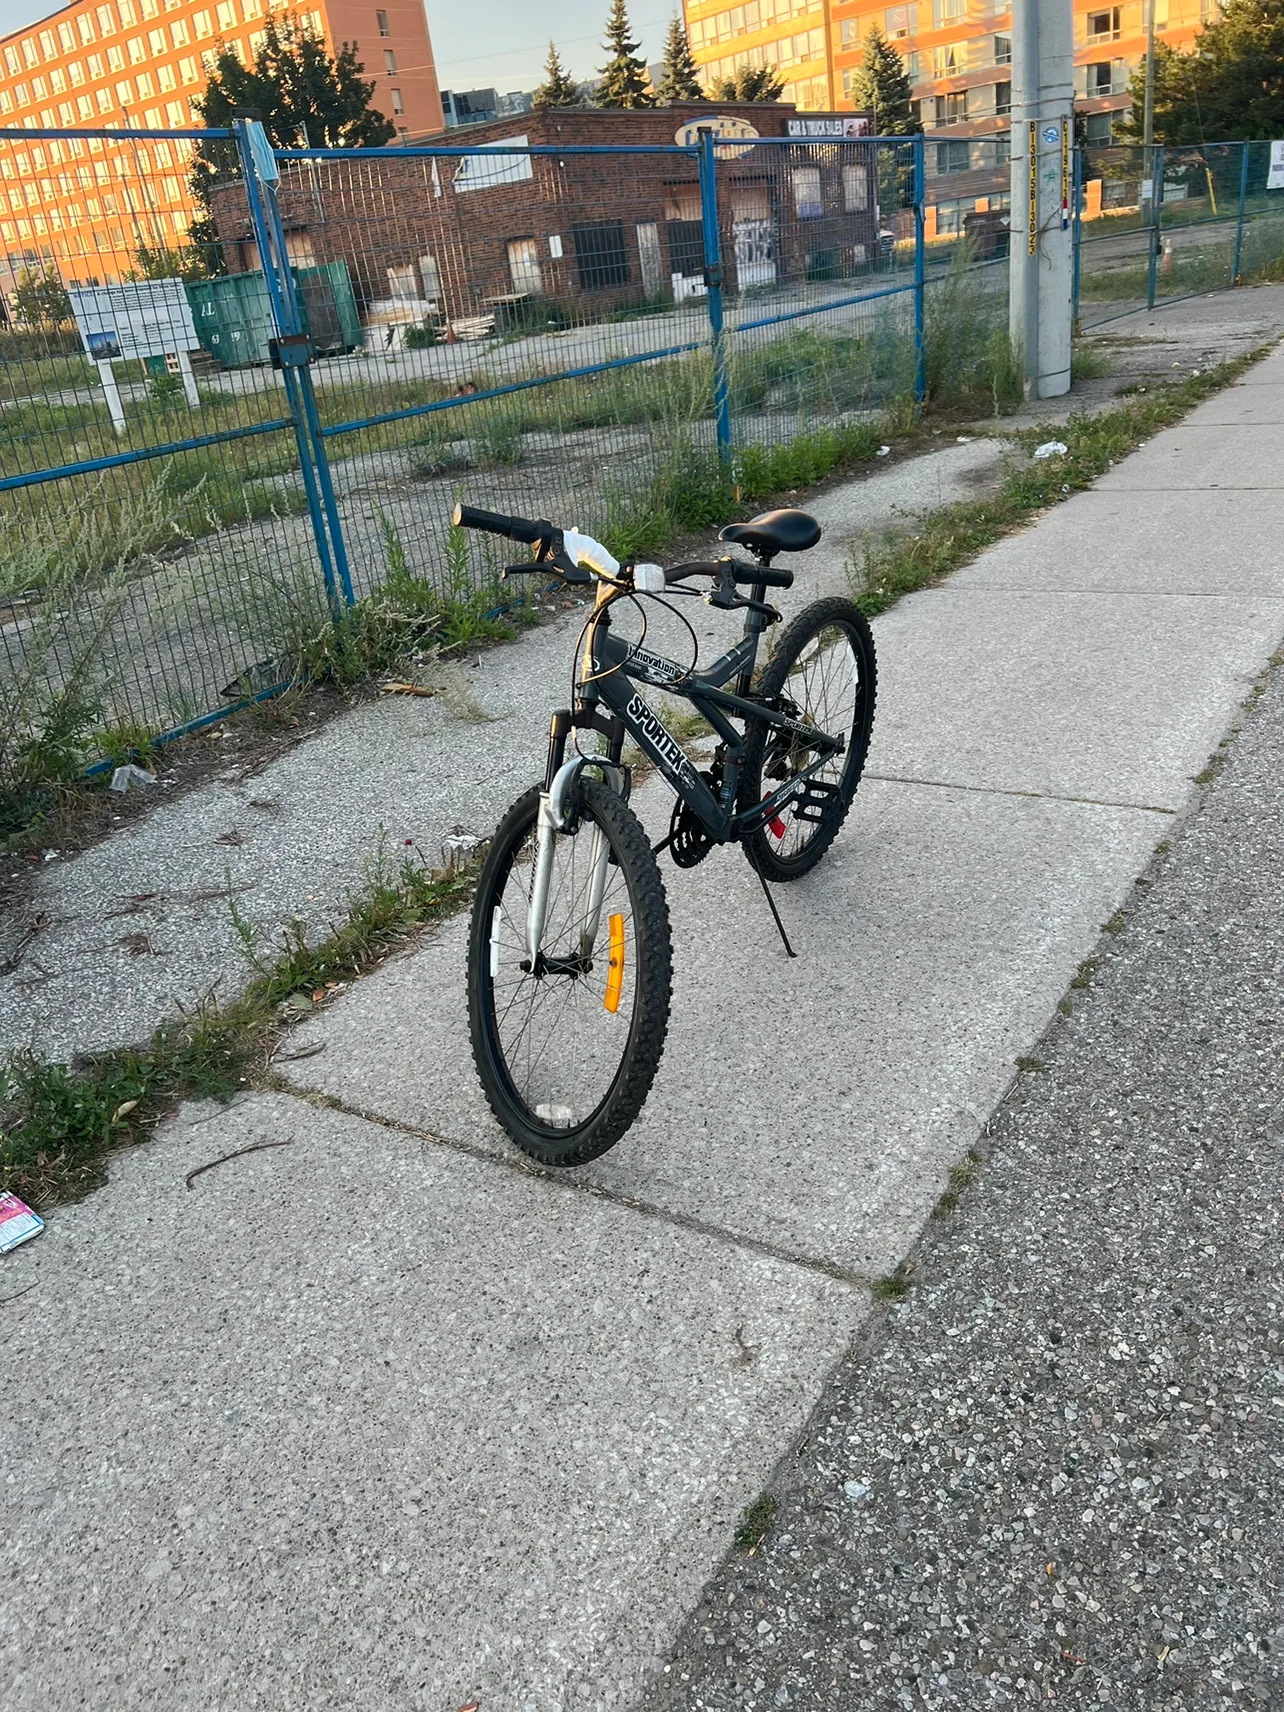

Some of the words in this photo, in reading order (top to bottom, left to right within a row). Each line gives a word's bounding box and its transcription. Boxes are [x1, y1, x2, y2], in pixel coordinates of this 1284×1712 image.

[788, 120, 801, 136] CAR
[806, 120, 826, 136] TRUCK
[626, 693, 688, 775] SPORTEK
